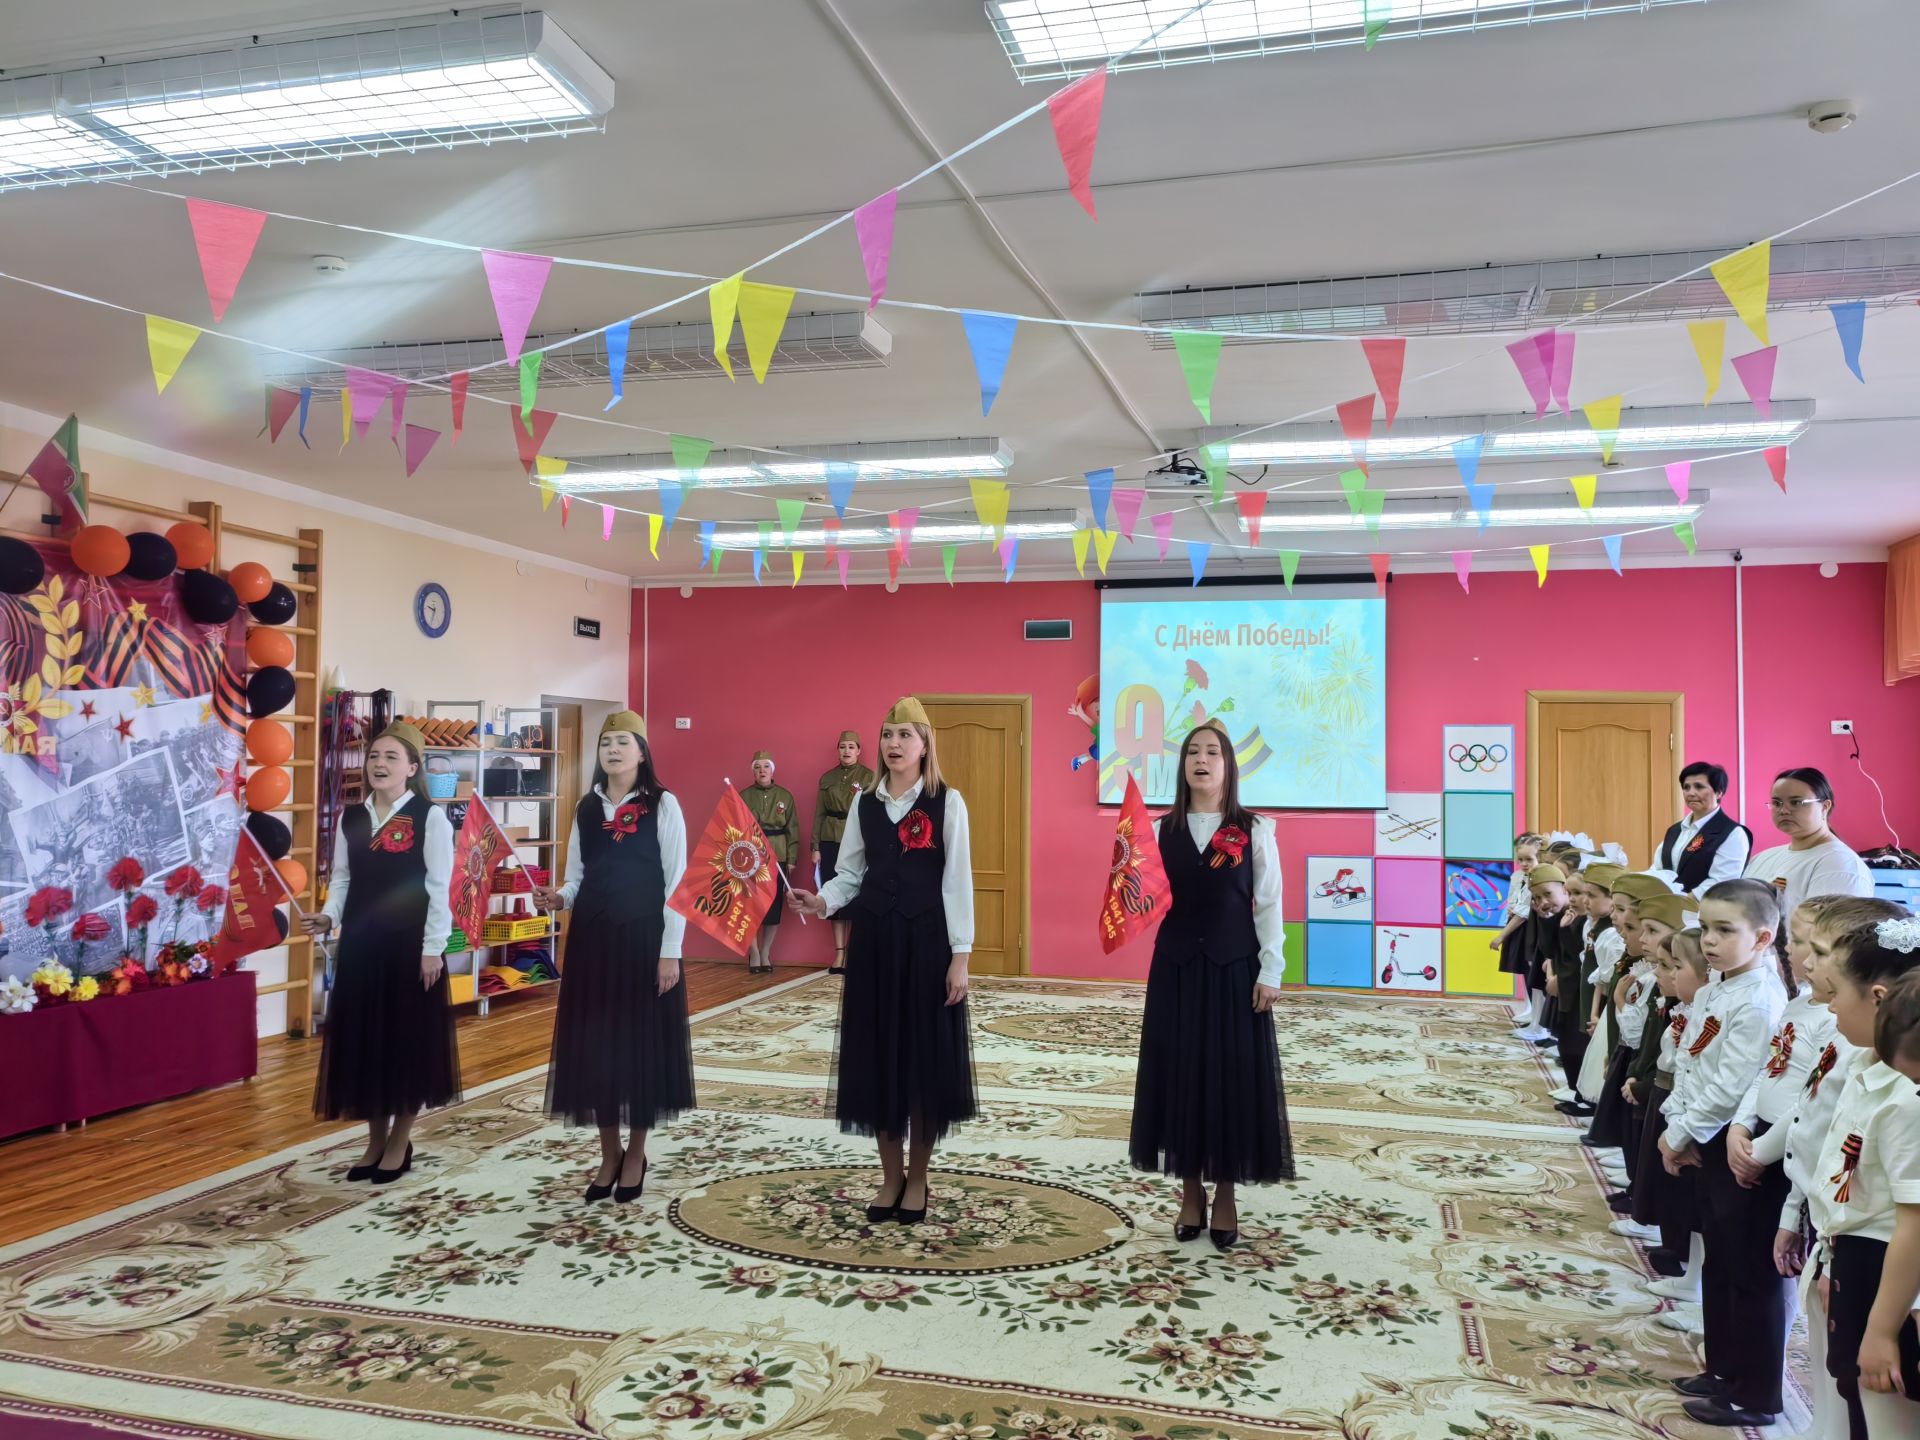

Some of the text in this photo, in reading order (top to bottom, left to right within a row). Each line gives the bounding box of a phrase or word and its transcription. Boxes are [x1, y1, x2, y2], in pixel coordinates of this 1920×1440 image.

[579, 623, 597, 635] ВЫХОД
[1155, 622, 1331, 651] С Днём Победы!
[1103, 910, 1116, 939] 1945
[1109, 896, 1126, 925] 1941
